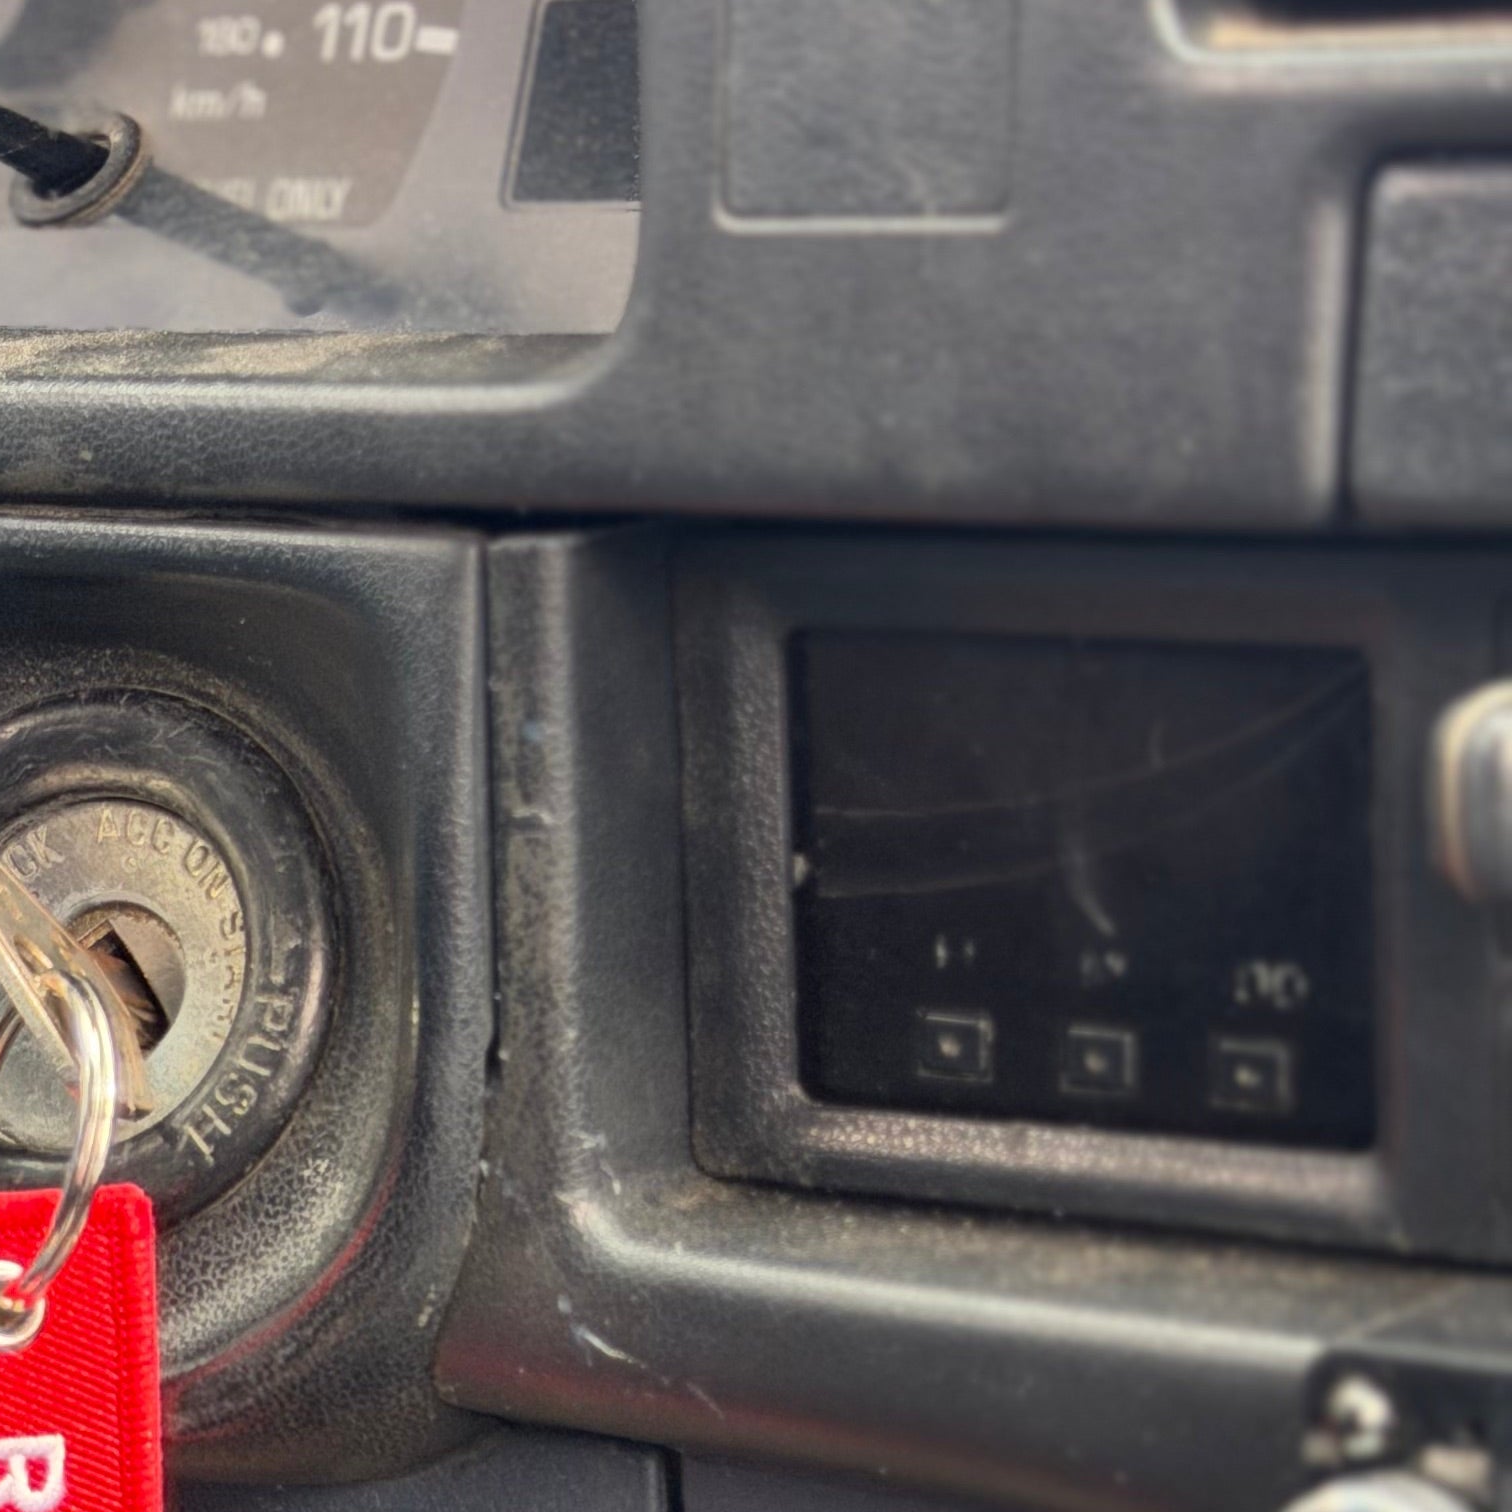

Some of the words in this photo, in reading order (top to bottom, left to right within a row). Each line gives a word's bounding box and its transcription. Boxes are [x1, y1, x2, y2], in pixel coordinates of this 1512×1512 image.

[312, 1, 417, 63] 110
[1, 825, 65, 883] CK
[96, 807, 176, 855] ACC
[183, 838, 232, 900] ON
[184, 986, 301, 1167] PUSH
